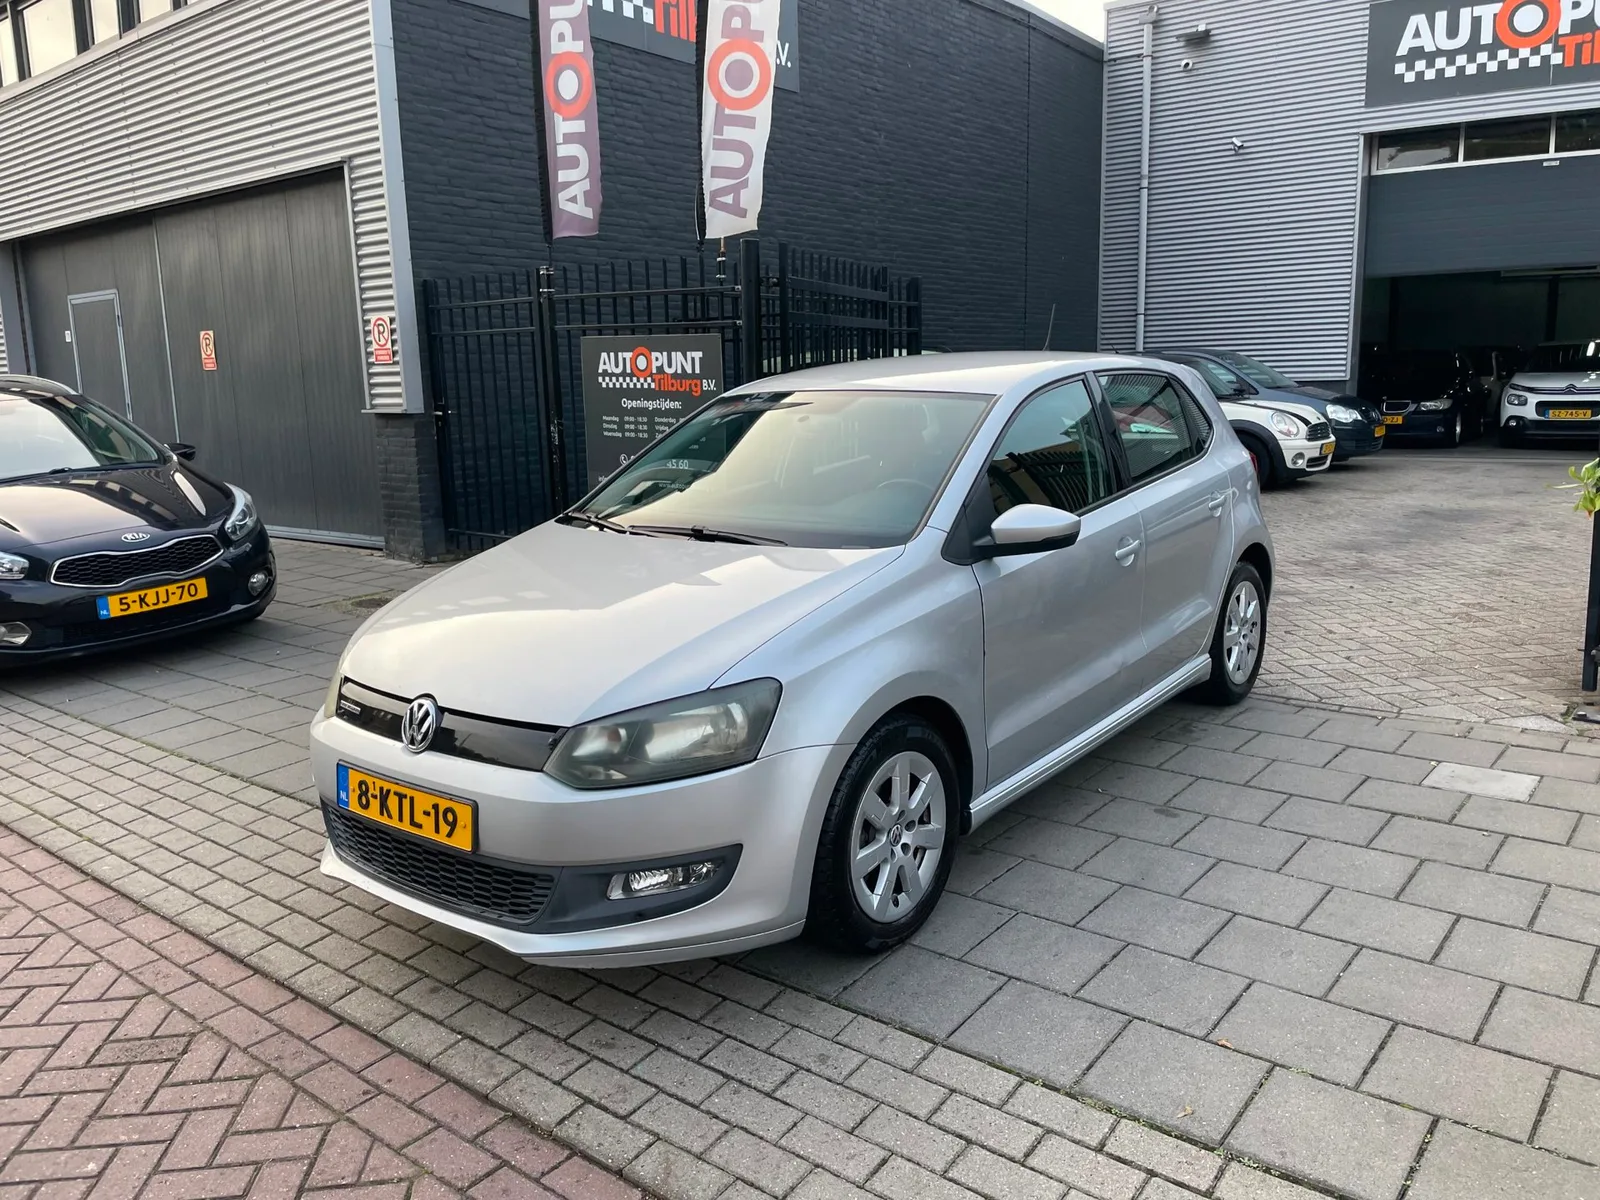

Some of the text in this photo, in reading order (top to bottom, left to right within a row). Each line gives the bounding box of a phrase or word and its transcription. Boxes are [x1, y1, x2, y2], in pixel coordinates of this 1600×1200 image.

[1395, 0, 1600, 56] AUTOP
[707, 0, 771, 219] AUTOP
[598, 347, 703, 378] AUTOPUNT
[653, 374, 717, 396] Tilburg B.V.
[621, 398, 682, 410] Openingstijden:
[1552, 410, 1588, 418] SZ-745-V
[123, 532, 149, 541] KIA
[118, 583, 198, 612] 5-KJJ-70
[340, 790, 348, 802] NL
[357, 779, 458, 838] 8-KTL-19
